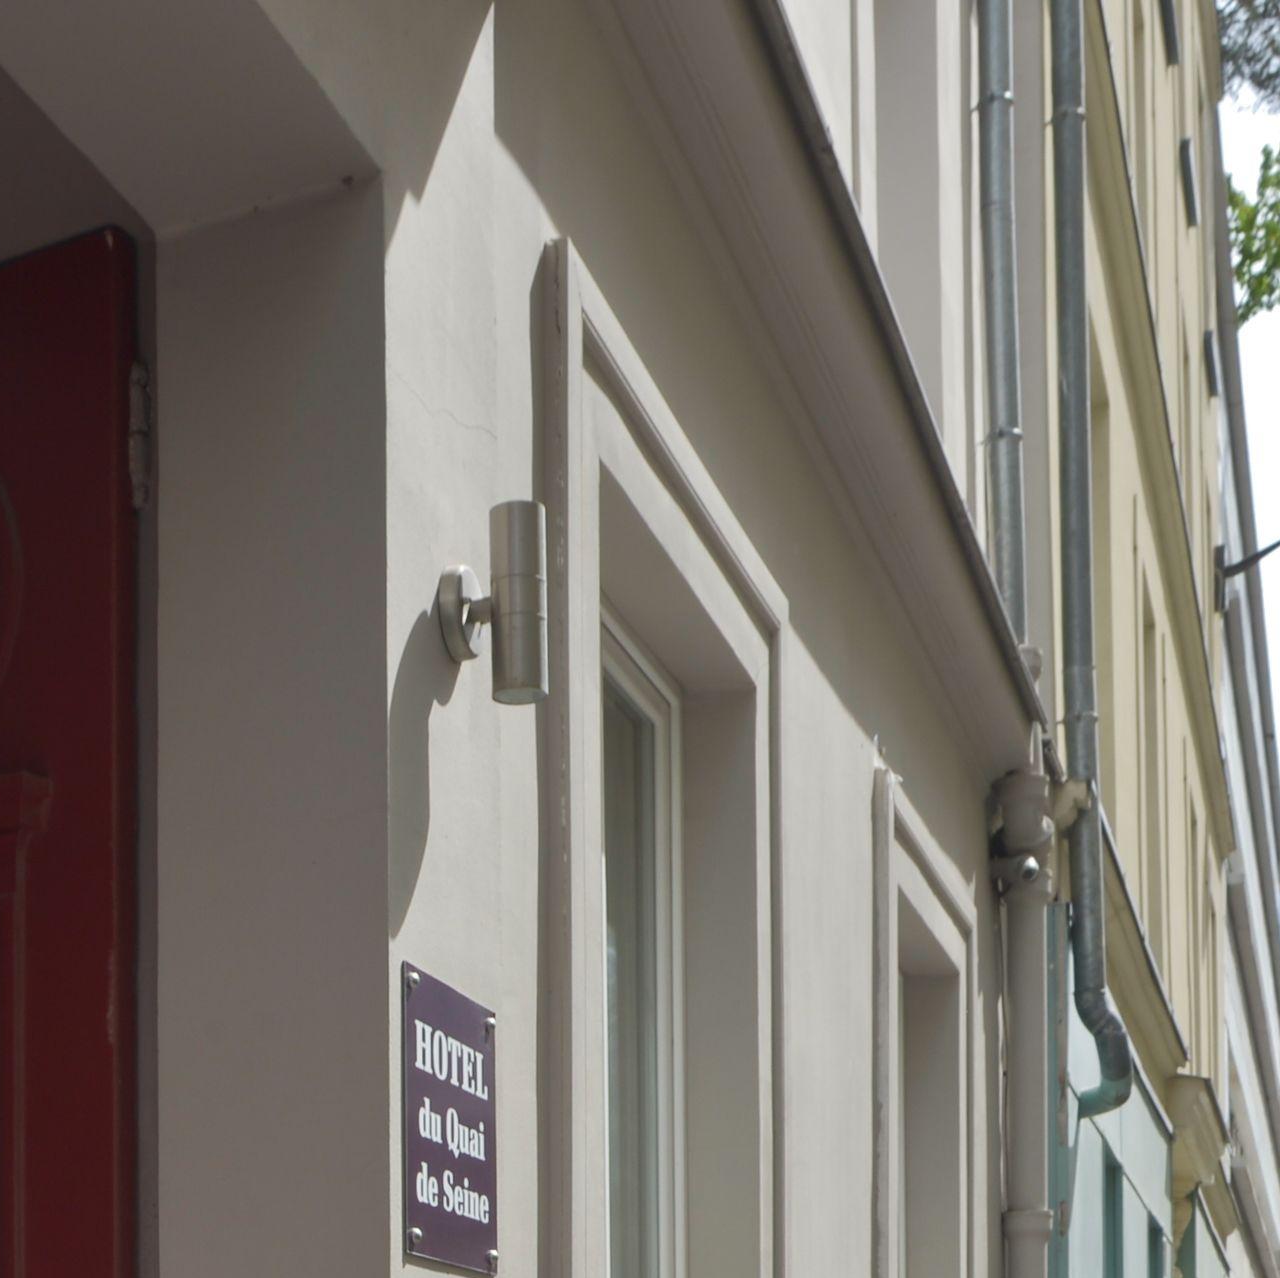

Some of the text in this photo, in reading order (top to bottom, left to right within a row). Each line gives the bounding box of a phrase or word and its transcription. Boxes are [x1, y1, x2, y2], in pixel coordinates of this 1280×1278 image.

[414, 1018, 489, 1101] HOTEL
[418, 1096, 486, 1161] du Quai
[415, 1161, 490, 1224] de Seine
